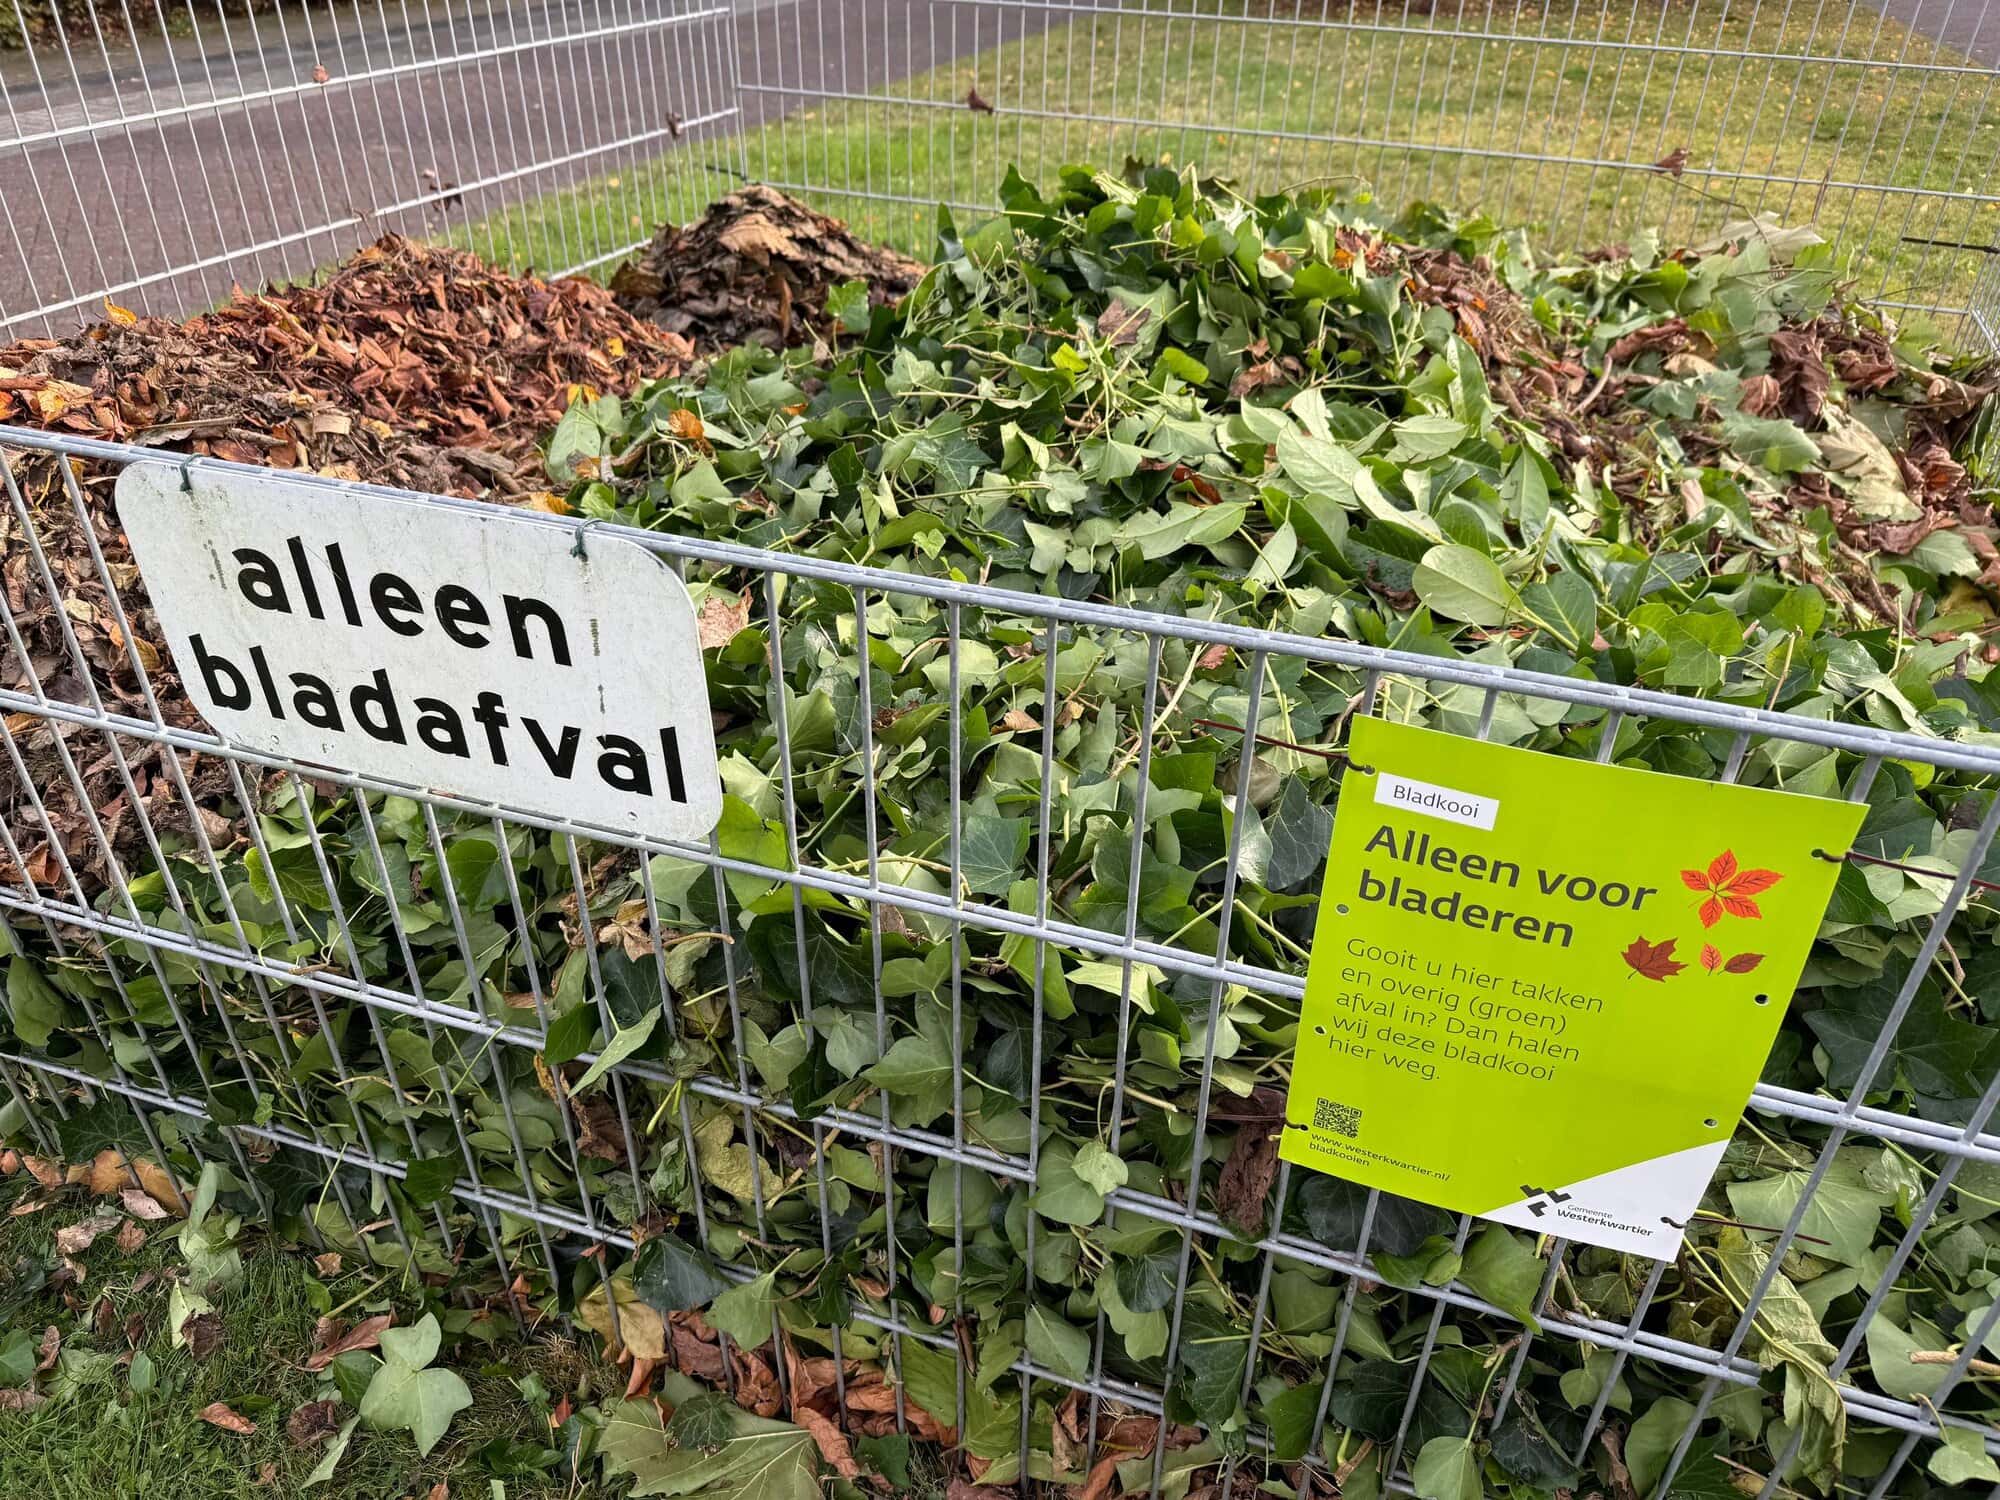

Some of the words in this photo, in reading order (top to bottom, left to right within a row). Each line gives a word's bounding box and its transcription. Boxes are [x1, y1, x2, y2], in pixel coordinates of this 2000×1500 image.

[231, 535, 573, 667] alleen
[188, 632, 688, 804] bladafval
[1393, 784, 1481, 819] Bladkooi
[1364, 824, 1521, 888] Alleen
[1537, 867, 1658, 911] voor
[1358, 868, 1574, 948] bladeren
[1341, 967, 1372, 987] en
[1381, 977, 1460, 1013] overig
[1469, 995, 1567, 1035] (groen)
[1347, 938, 1417, 971] Gooit
[1427, 962, 1442, 976] u
[1451, 962, 1504, 990] hier
[1512, 979, 1604, 1013] takken
[1328, 1034, 1376, 1059] hier
[1383, 1052, 1441, 1081] weg.
[1332, 1016, 1368, 1038] wij
[1376, 1026, 1435, 1054] deze
[1444, 1040, 1555, 1081] bladkooi
[1335, 991, 1395, 1018] afval
[1403, 1004, 1437, 1027] in?
[1446, 1017, 1499, 1043] Dan
[1508, 1031, 1581, 1062] halen
[1309, 1142, 1370, 1167] bladkooien
[1310, 1133, 1452, 1181] www.westerkwartier.nl/
[1557, 1208, 1654, 1237] Westerkwartier
[1567, 1204, 1614, 1219] Gemeente
